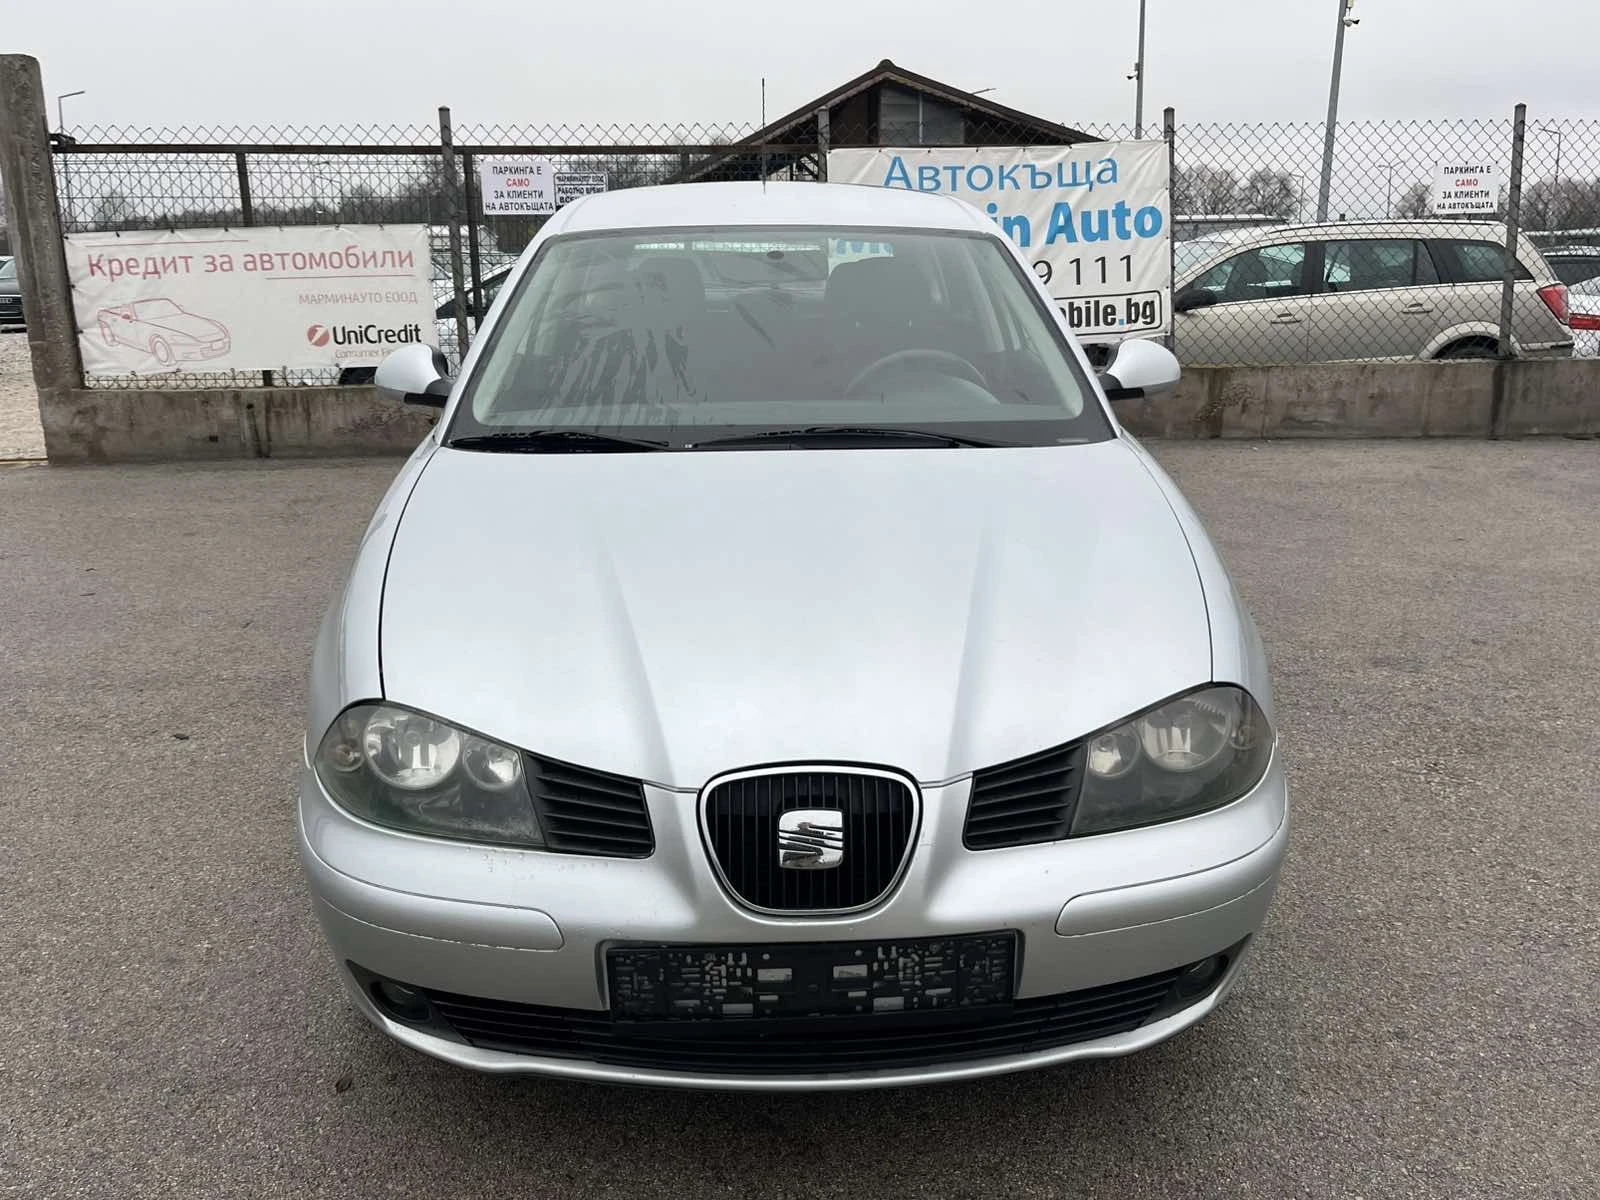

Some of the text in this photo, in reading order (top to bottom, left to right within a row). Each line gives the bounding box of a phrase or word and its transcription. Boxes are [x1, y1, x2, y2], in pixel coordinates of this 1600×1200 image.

[492, 166, 542, 175] ПАРКИНГА Е
[884, 155, 1118, 192] Автокъща
[1443, 165, 1492, 175] ПАРКИНГА Е
[506, 178, 530, 187] САМО
[1455, 178, 1479, 187] САМО
[494, 190, 544, 199] ЗА КЛИЕНТИ
[1442, 190, 1490, 199] ЗА КЛИЕНТИ
[485, 202, 554, 211] НА АВТОКЪЩАТА
[1436, 201, 1494, 210] НА АВТОКЪЩАТА
[1046, 200, 1163, 245] Auto
[87, 244, 415, 282] Кредит за автомобили
[298, 292, 382, 305] МАРМИНАУТО
[332, 323, 422, 345] UniCredit
